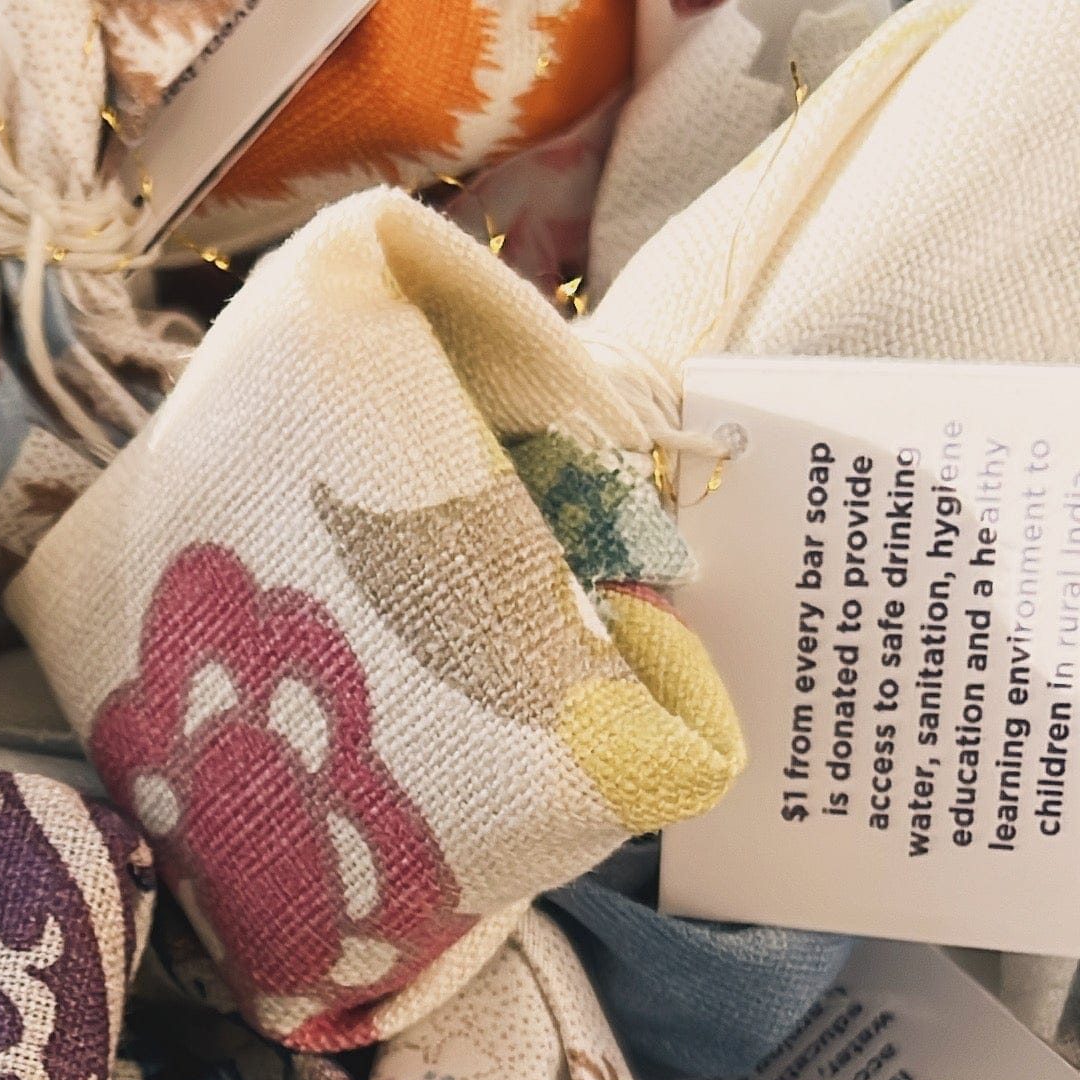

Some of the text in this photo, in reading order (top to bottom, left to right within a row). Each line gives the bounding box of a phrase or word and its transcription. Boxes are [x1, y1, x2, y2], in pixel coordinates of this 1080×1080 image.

[780, 442, 835, 823] $1 from every bar soap
[822, 455, 873, 816] is donated to provide
[869, 447, 921, 830] access to safe drinking
[908, 420, 962, 857] water, sanitation, hygiene
[948, 438, 1010, 847] education and a healthy
[988, 439, 1049, 851] learning environment to
[1034, 702, 1072, 836] children
[1046, 661, 1073, 689] in
